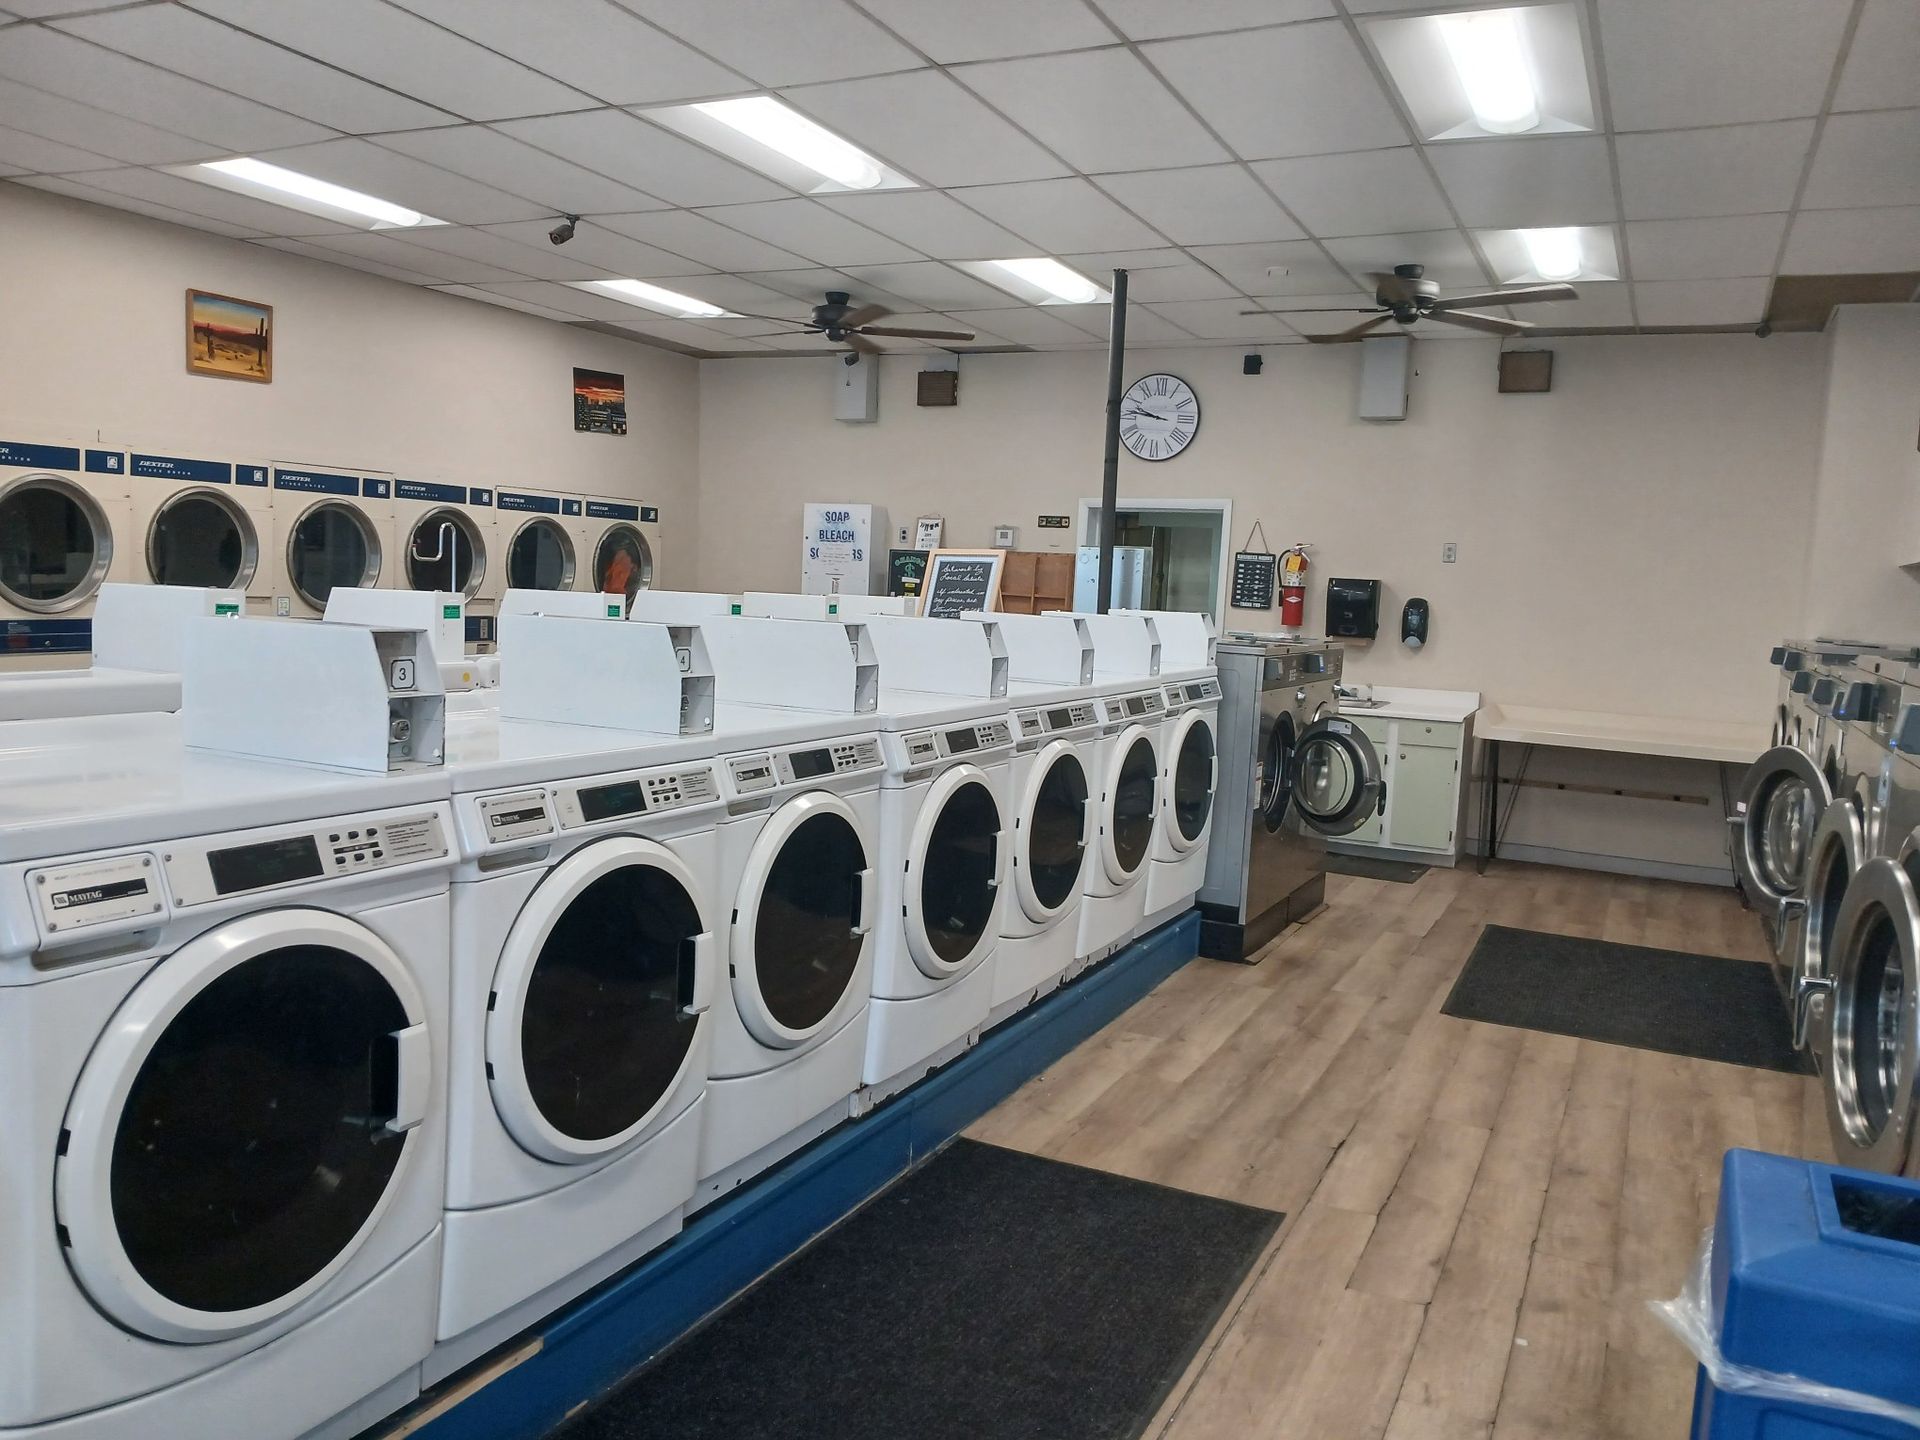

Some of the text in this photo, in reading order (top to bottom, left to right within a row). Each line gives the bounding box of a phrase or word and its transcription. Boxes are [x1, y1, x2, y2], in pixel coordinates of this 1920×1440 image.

[1177, 414, 1194, 424] III
[139, 460, 174, 469] DEXTER
[825, 511, 850, 523] SOAP
[819, 530, 855, 541] BLEACH
[680, 656, 686, 665] 4
[399, 668, 406, 681] 3
[68, 890, 103, 902] MAYTAG
